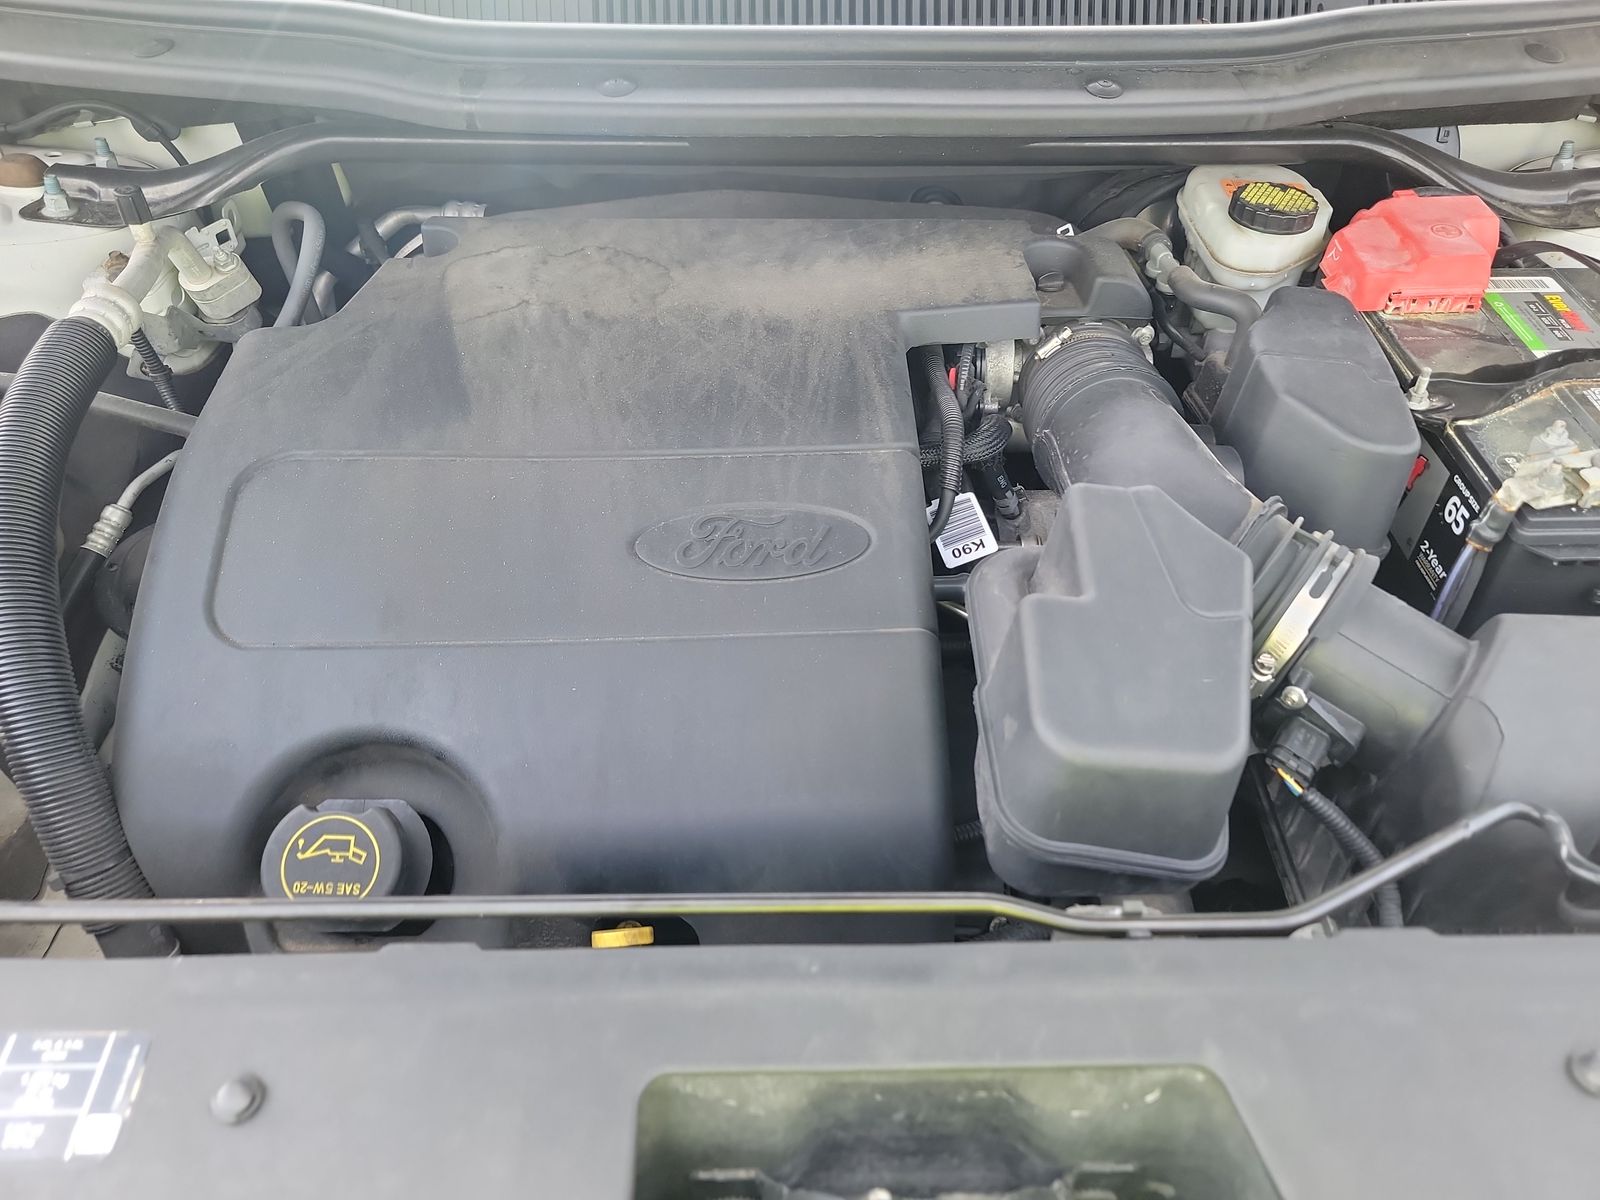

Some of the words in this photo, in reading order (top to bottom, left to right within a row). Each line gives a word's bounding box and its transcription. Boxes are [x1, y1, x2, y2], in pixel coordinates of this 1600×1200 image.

[1453, 474, 1471, 498] GROUP
[1444, 495, 1470, 535] 65
[675, 514, 832, 569] Ford
[952, 538, 985, 559] K90
[1420, 540, 1447, 580] 2-Year
[292, 880, 334, 895] 5W-20
[336, 881, 361, 896] SAE
